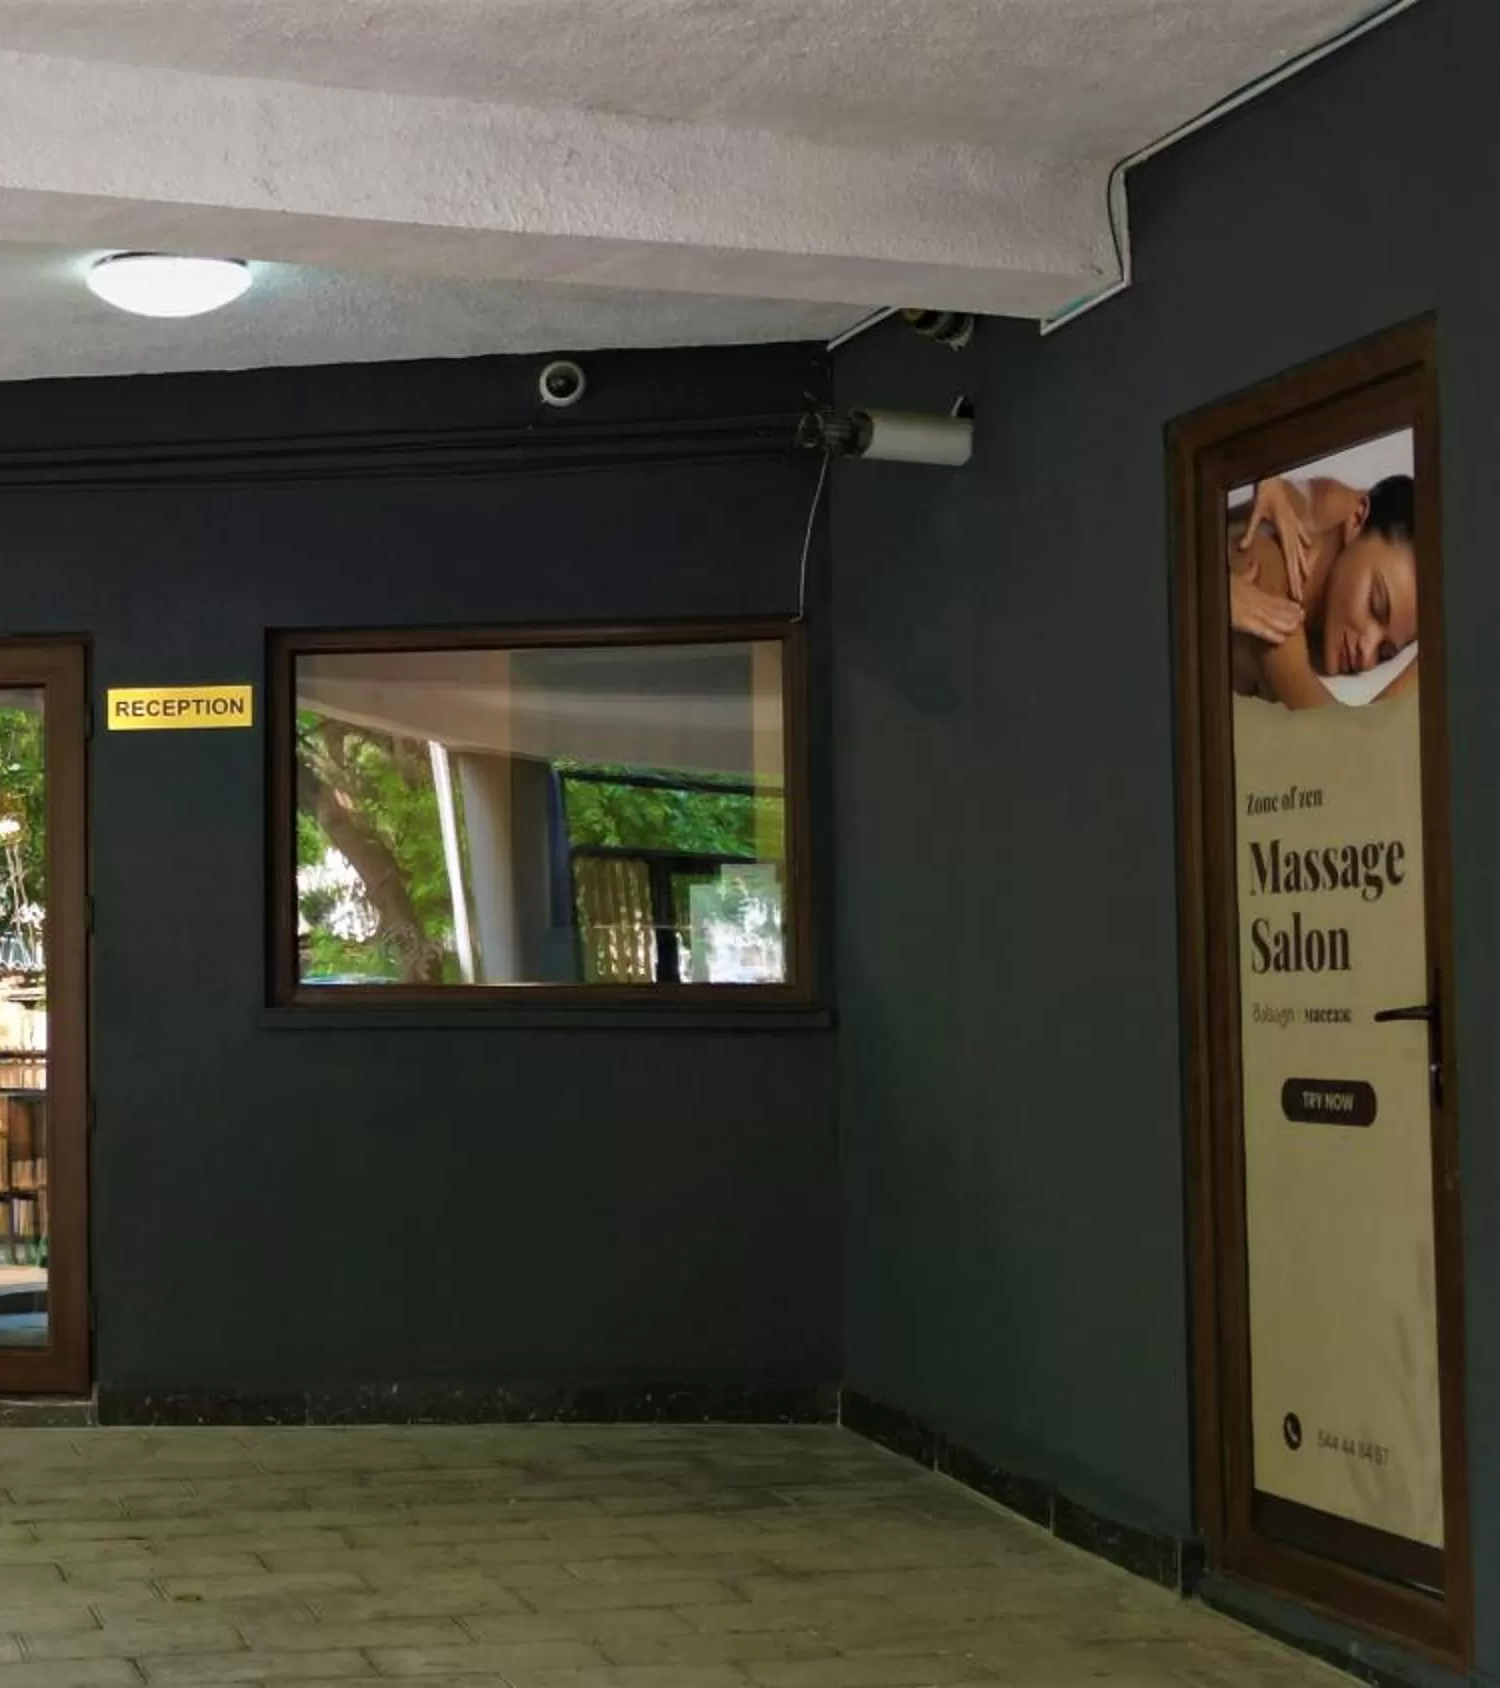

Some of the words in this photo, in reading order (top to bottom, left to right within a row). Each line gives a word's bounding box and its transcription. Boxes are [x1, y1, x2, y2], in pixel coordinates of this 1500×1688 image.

[115, 697, 245, 717] RECEPTION
[1246, 791, 1279, 816] Zone
[1281, 785, 1298, 811] of
[1299, 789, 1323, 810] zen
[1250, 838, 1405, 902] Massage
[1251, 911, 1351, 975] Salon
[1302, 1090, 1322, 1112] TRY
[1325, 1091, 1355, 1113] NOW
